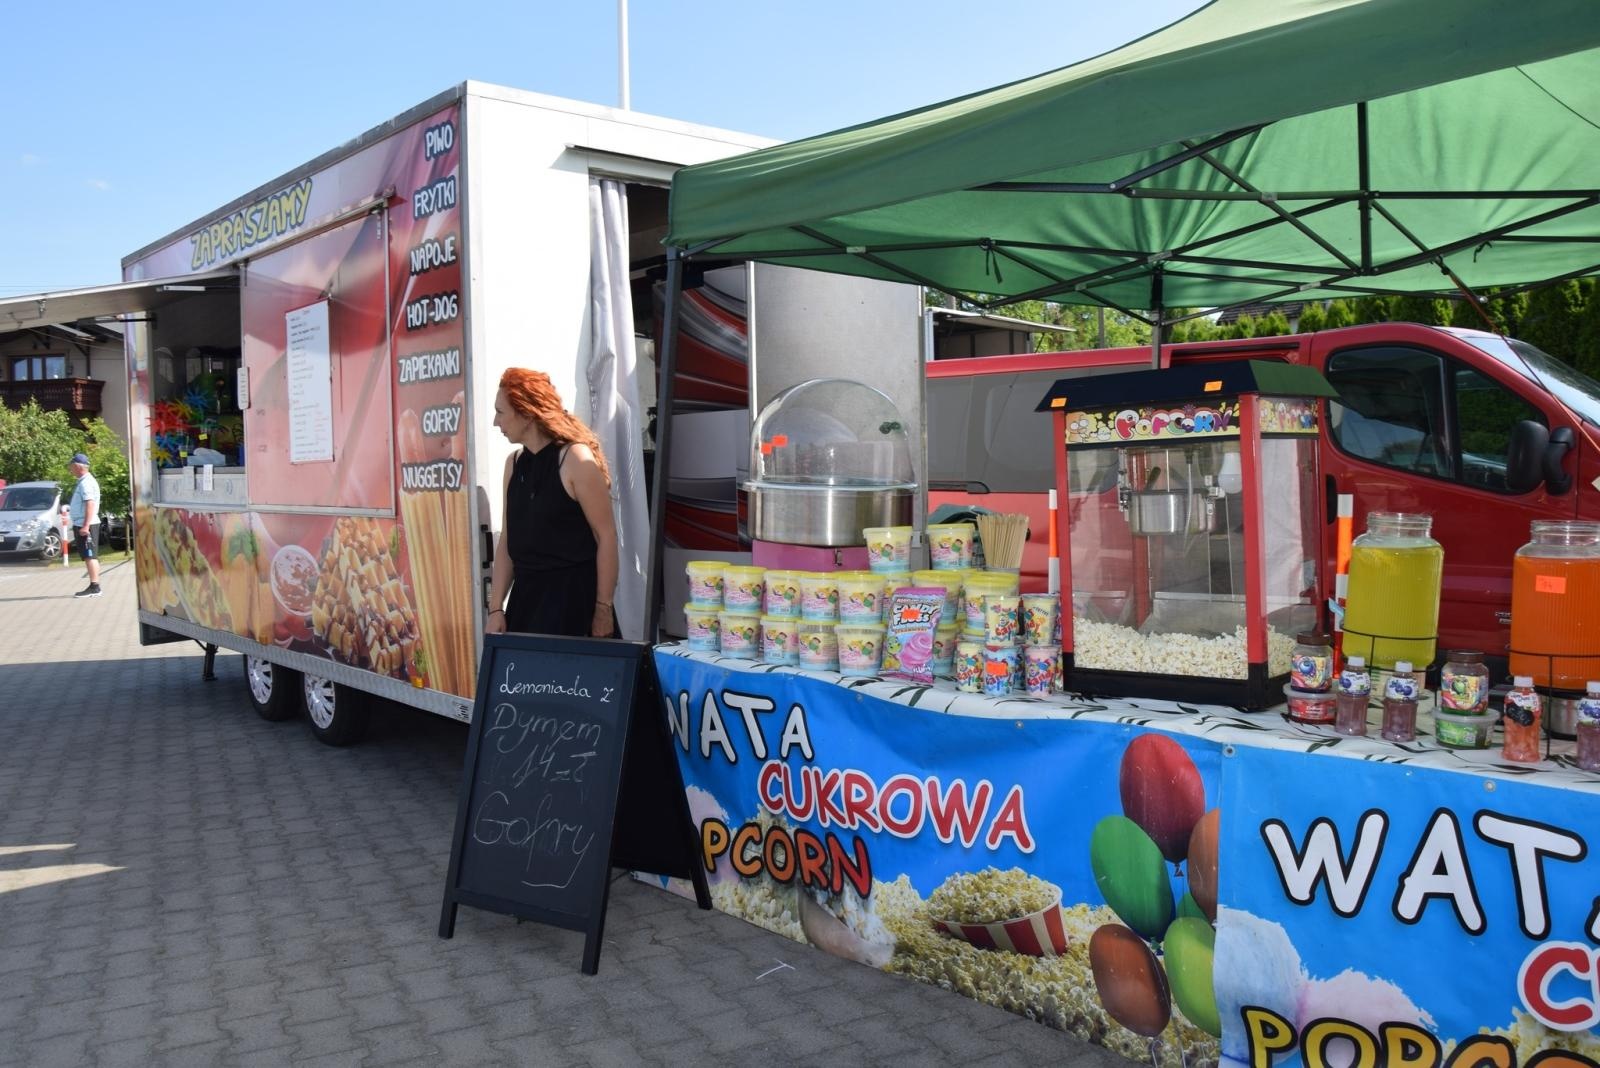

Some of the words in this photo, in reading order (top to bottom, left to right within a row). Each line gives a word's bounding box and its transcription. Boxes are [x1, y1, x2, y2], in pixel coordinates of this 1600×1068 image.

[425, 122, 454, 160] PIWO
[414, 178, 455, 218] FRYTKI
[191, 178, 313, 271] ZAPRASZAMY
[410, 236, 457, 274] NAPOJE
[406, 294, 459, 329] HOT-DOG
[398, 349, 461, 384] ZAPIEKANKI
[422, 406, 462, 435] GOFRY
[402, 463, 463, 489] NUGGETSY
[500, 662, 592, 698] Lemoniada
[758, 760, 1036, 853] CUKROWA
[474, 791, 595, 888] Gofry
[701, 817, 872, 898] PCORN
[1261, 807, 1600, 944] WAT
[1518, 941, 1600, 1031] C
